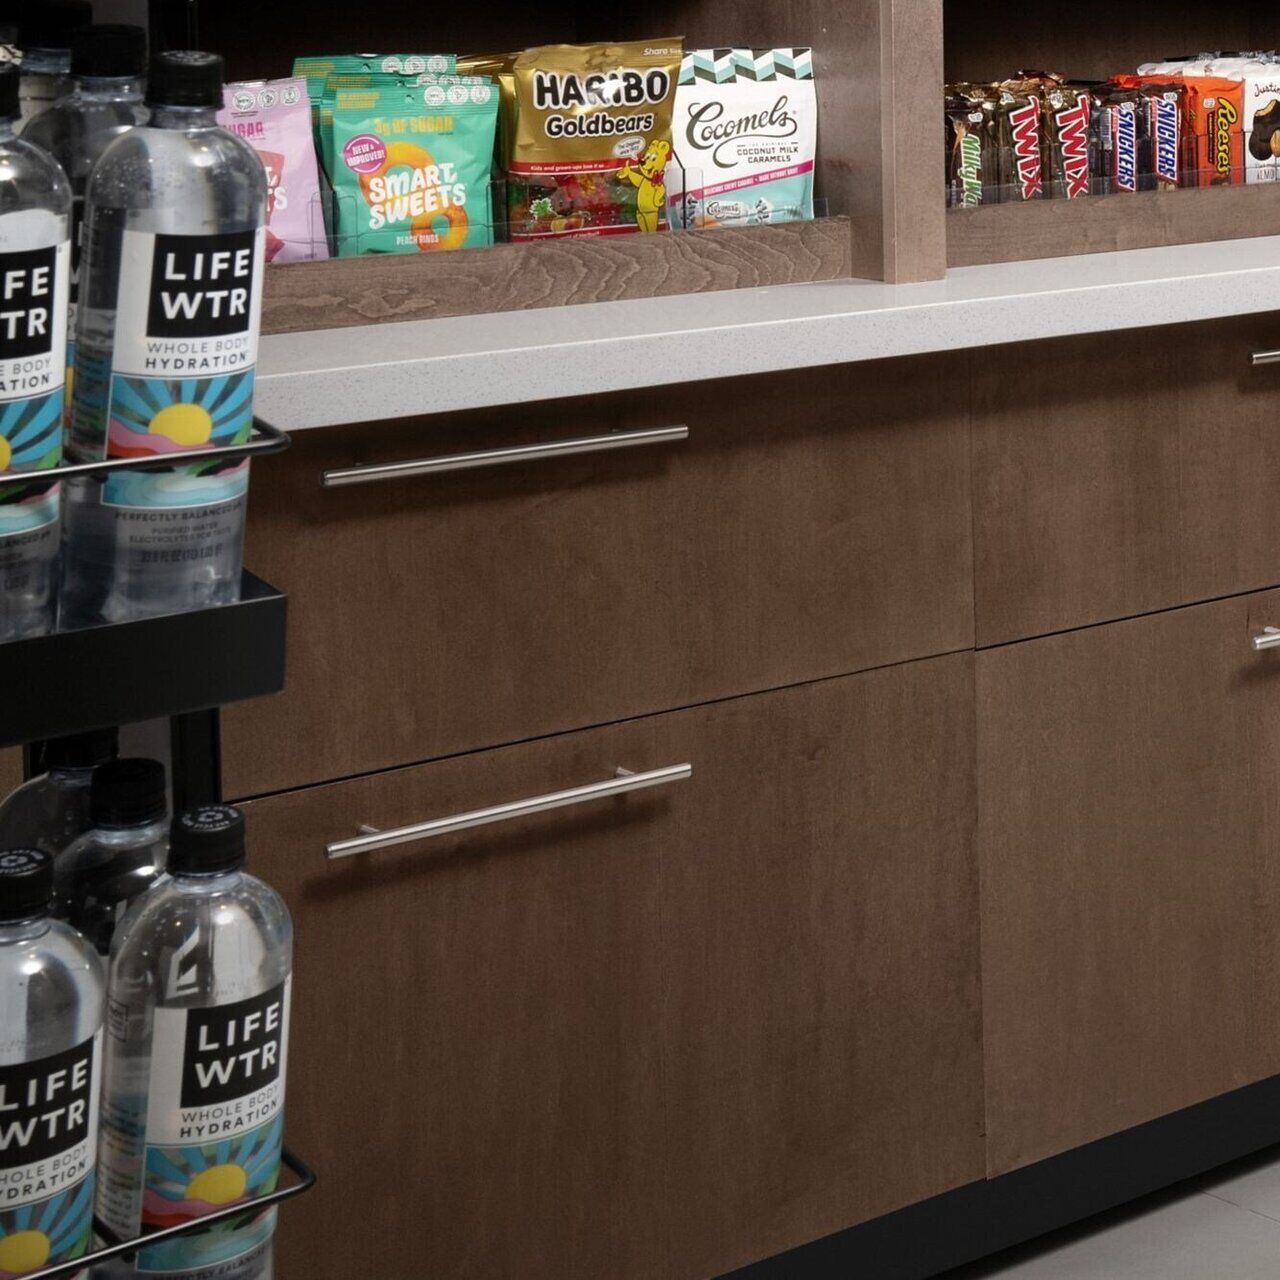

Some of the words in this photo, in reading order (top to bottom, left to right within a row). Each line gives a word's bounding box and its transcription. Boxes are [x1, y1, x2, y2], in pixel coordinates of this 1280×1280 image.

[535, 70, 668, 108] HARIBO
[546, 113, 654, 137] Goldbears
[686, 95, 798, 168] Cocomels
[1156, 99, 1180, 181] SNICKERS
[347, 150, 385, 166] IMPROVED!
[737, 148, 776, 156] COCONUT
[779, 146, 799, 154] MILK
[748, 156, 791, 164] CARAMELS
[1010, 96, 1042, 199] TWIX
[1056, 94, 1089, 199] TWIX
[1116, 109, 1135, 192] SNICKERS
[370, 163, 458, 203] SMART
[369, 184, 466, 230] SWEETS
[165, 248, 250, 281] LIFE
[161, 288, 247, 321] WTR
[145, 352, 247, 370] HYDRATION
[148, 341, 208, 354] WHOLE
[216, 337, 247, 350] BODY
[200, 1001, 280, 1052] LIFE
[195, 1040, 276, 1089] WTR
[180, 1101, 277, 1138] HYDRATION
[182, 1101, 243, 1124] WHOLE
[249, 1084, 278, 1109] BODY
